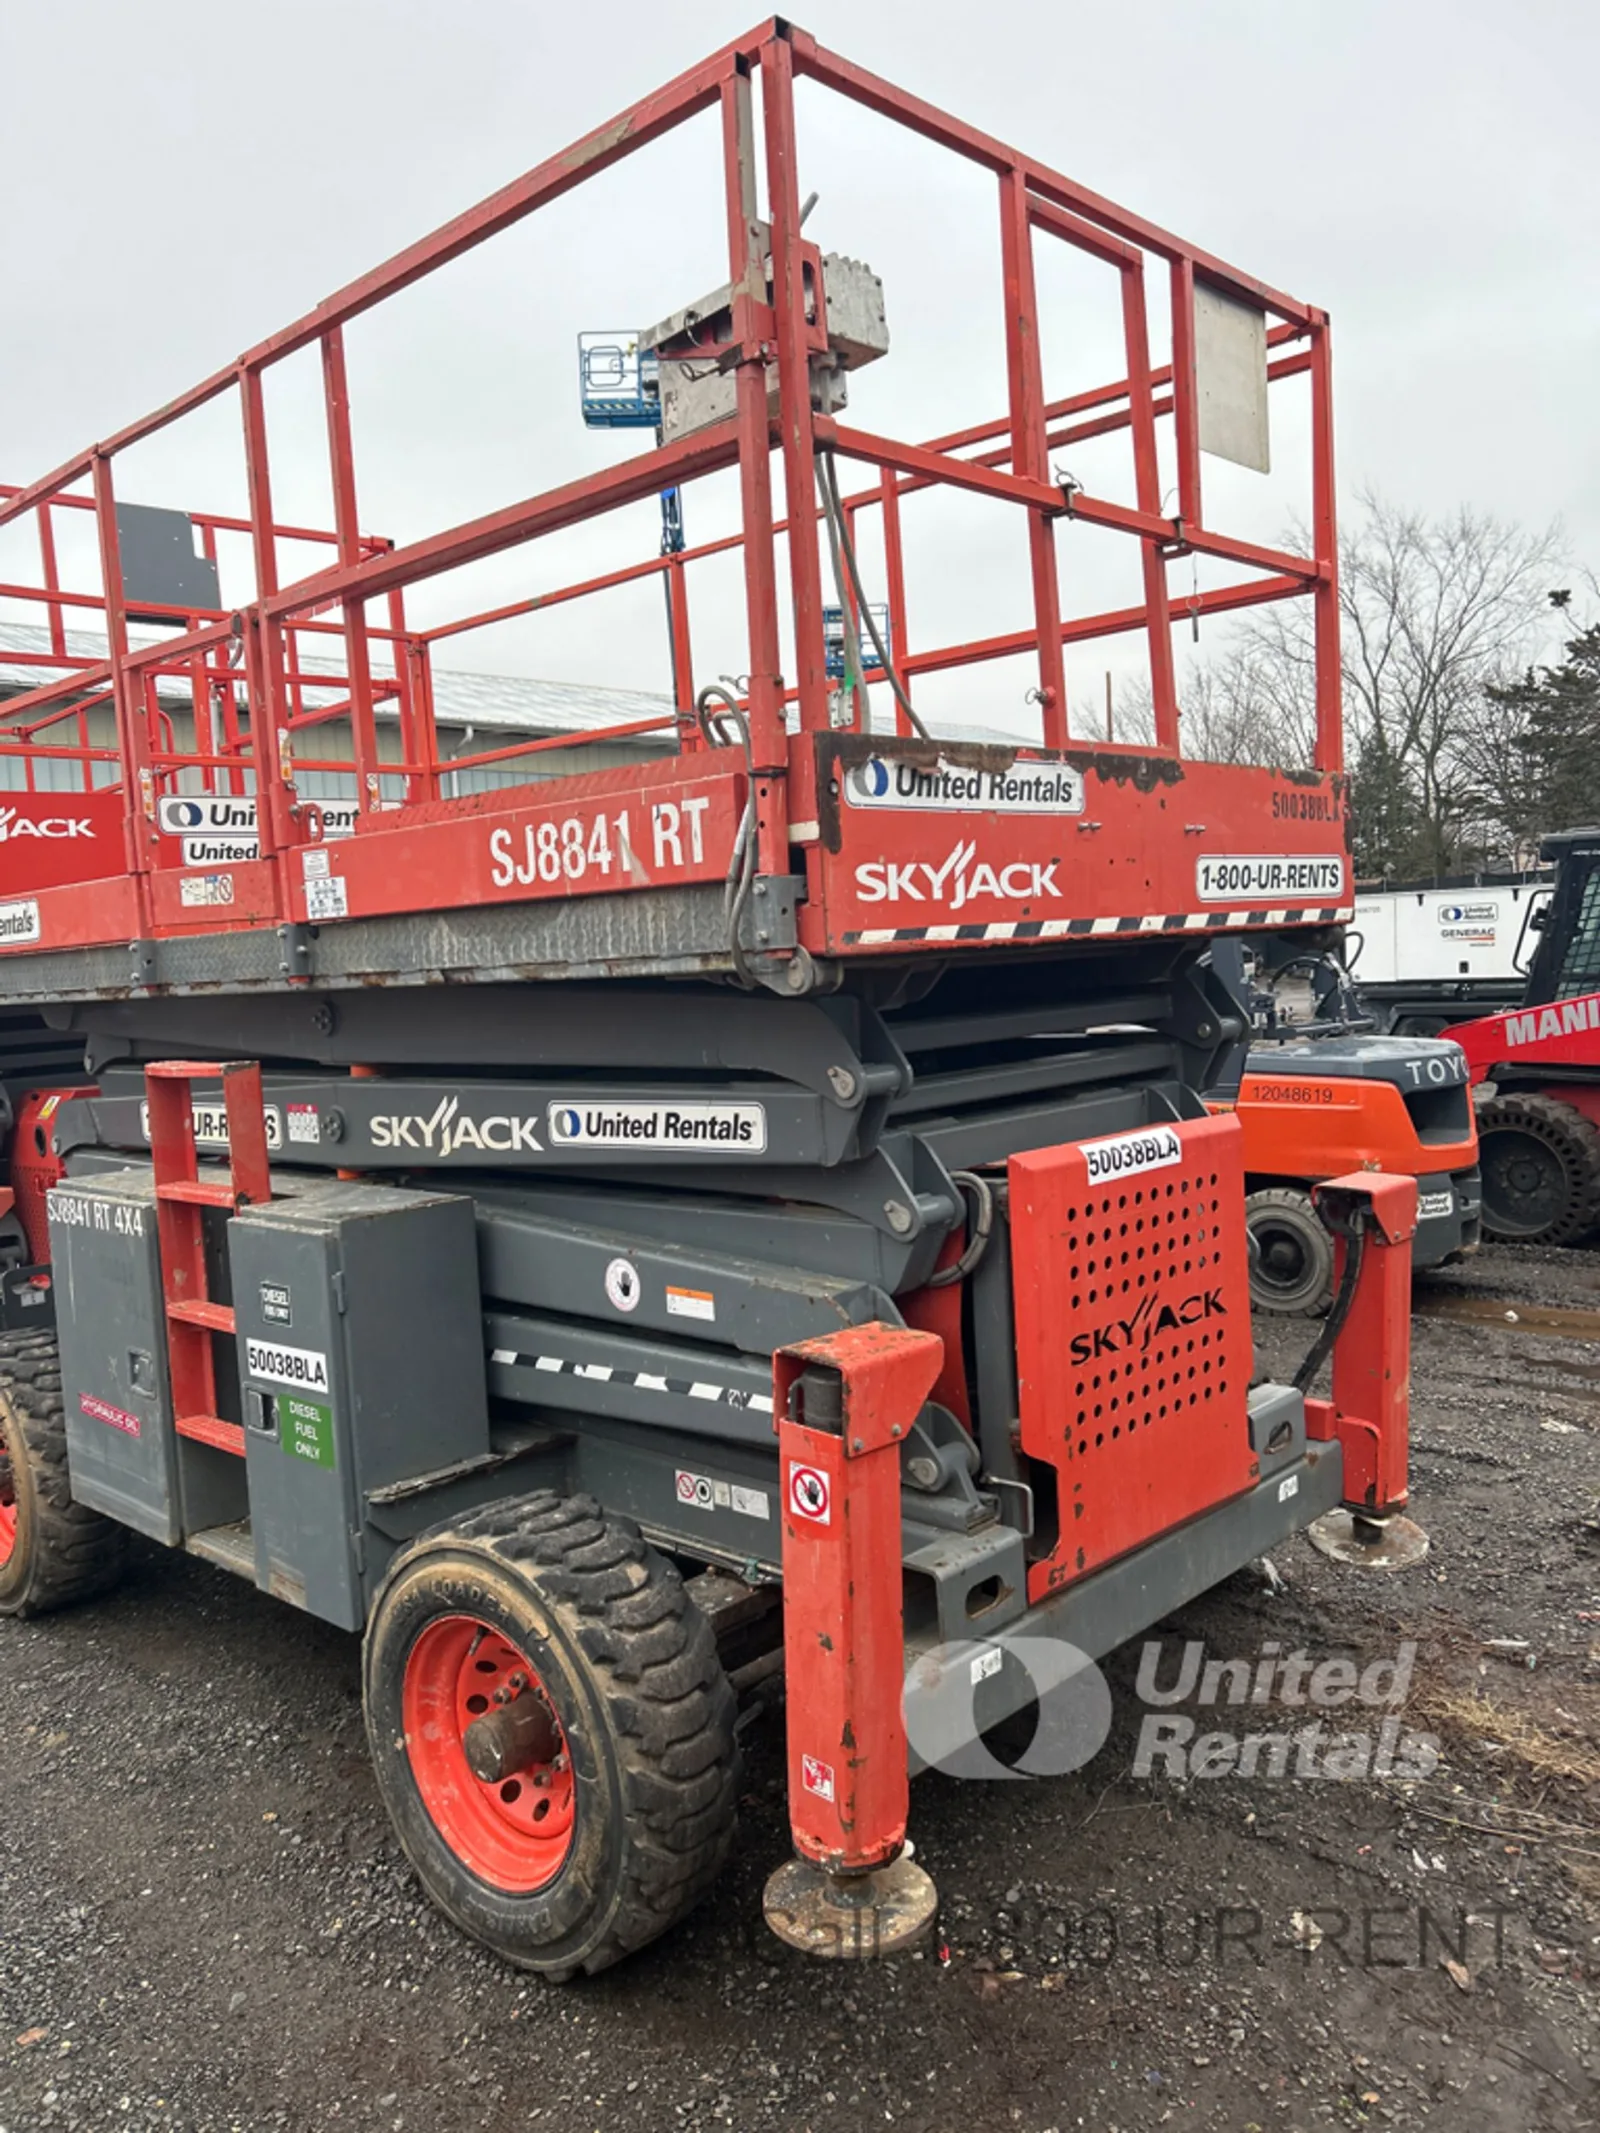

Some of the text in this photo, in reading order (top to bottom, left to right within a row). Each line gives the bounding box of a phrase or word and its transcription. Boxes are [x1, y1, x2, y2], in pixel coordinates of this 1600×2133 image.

[896, 763, 1073, 803] United Rentals
[190, 843, 258, 860] United
[488, 796, 710, 887] SJ8841 RT
[855, 839, 1063, 910] SKYJACK
[1201, 863, 1340, 891] 1-800-UR-RENTS
[1252, 1086, 1334, 1104] 12048619
[369, 1096, 545, 1158] SKYJACK
[586, 1112, 753, 1142] United Rentals
[1087, 1133, 1180, 1176] 50038BLA
[93, 1201, 110, 1231] RT
[114, 1206, 143, 1237] 4X4
[1069, 1286, 1228, 1366] SKYJACK
[248, 1346, 327, 1386] 50038BLA
[289, 1400, 322, 1423] DIESEL
[295, 1420, 319, 1441] FUEL
[295, 1440, 321, 1460] ONLY
